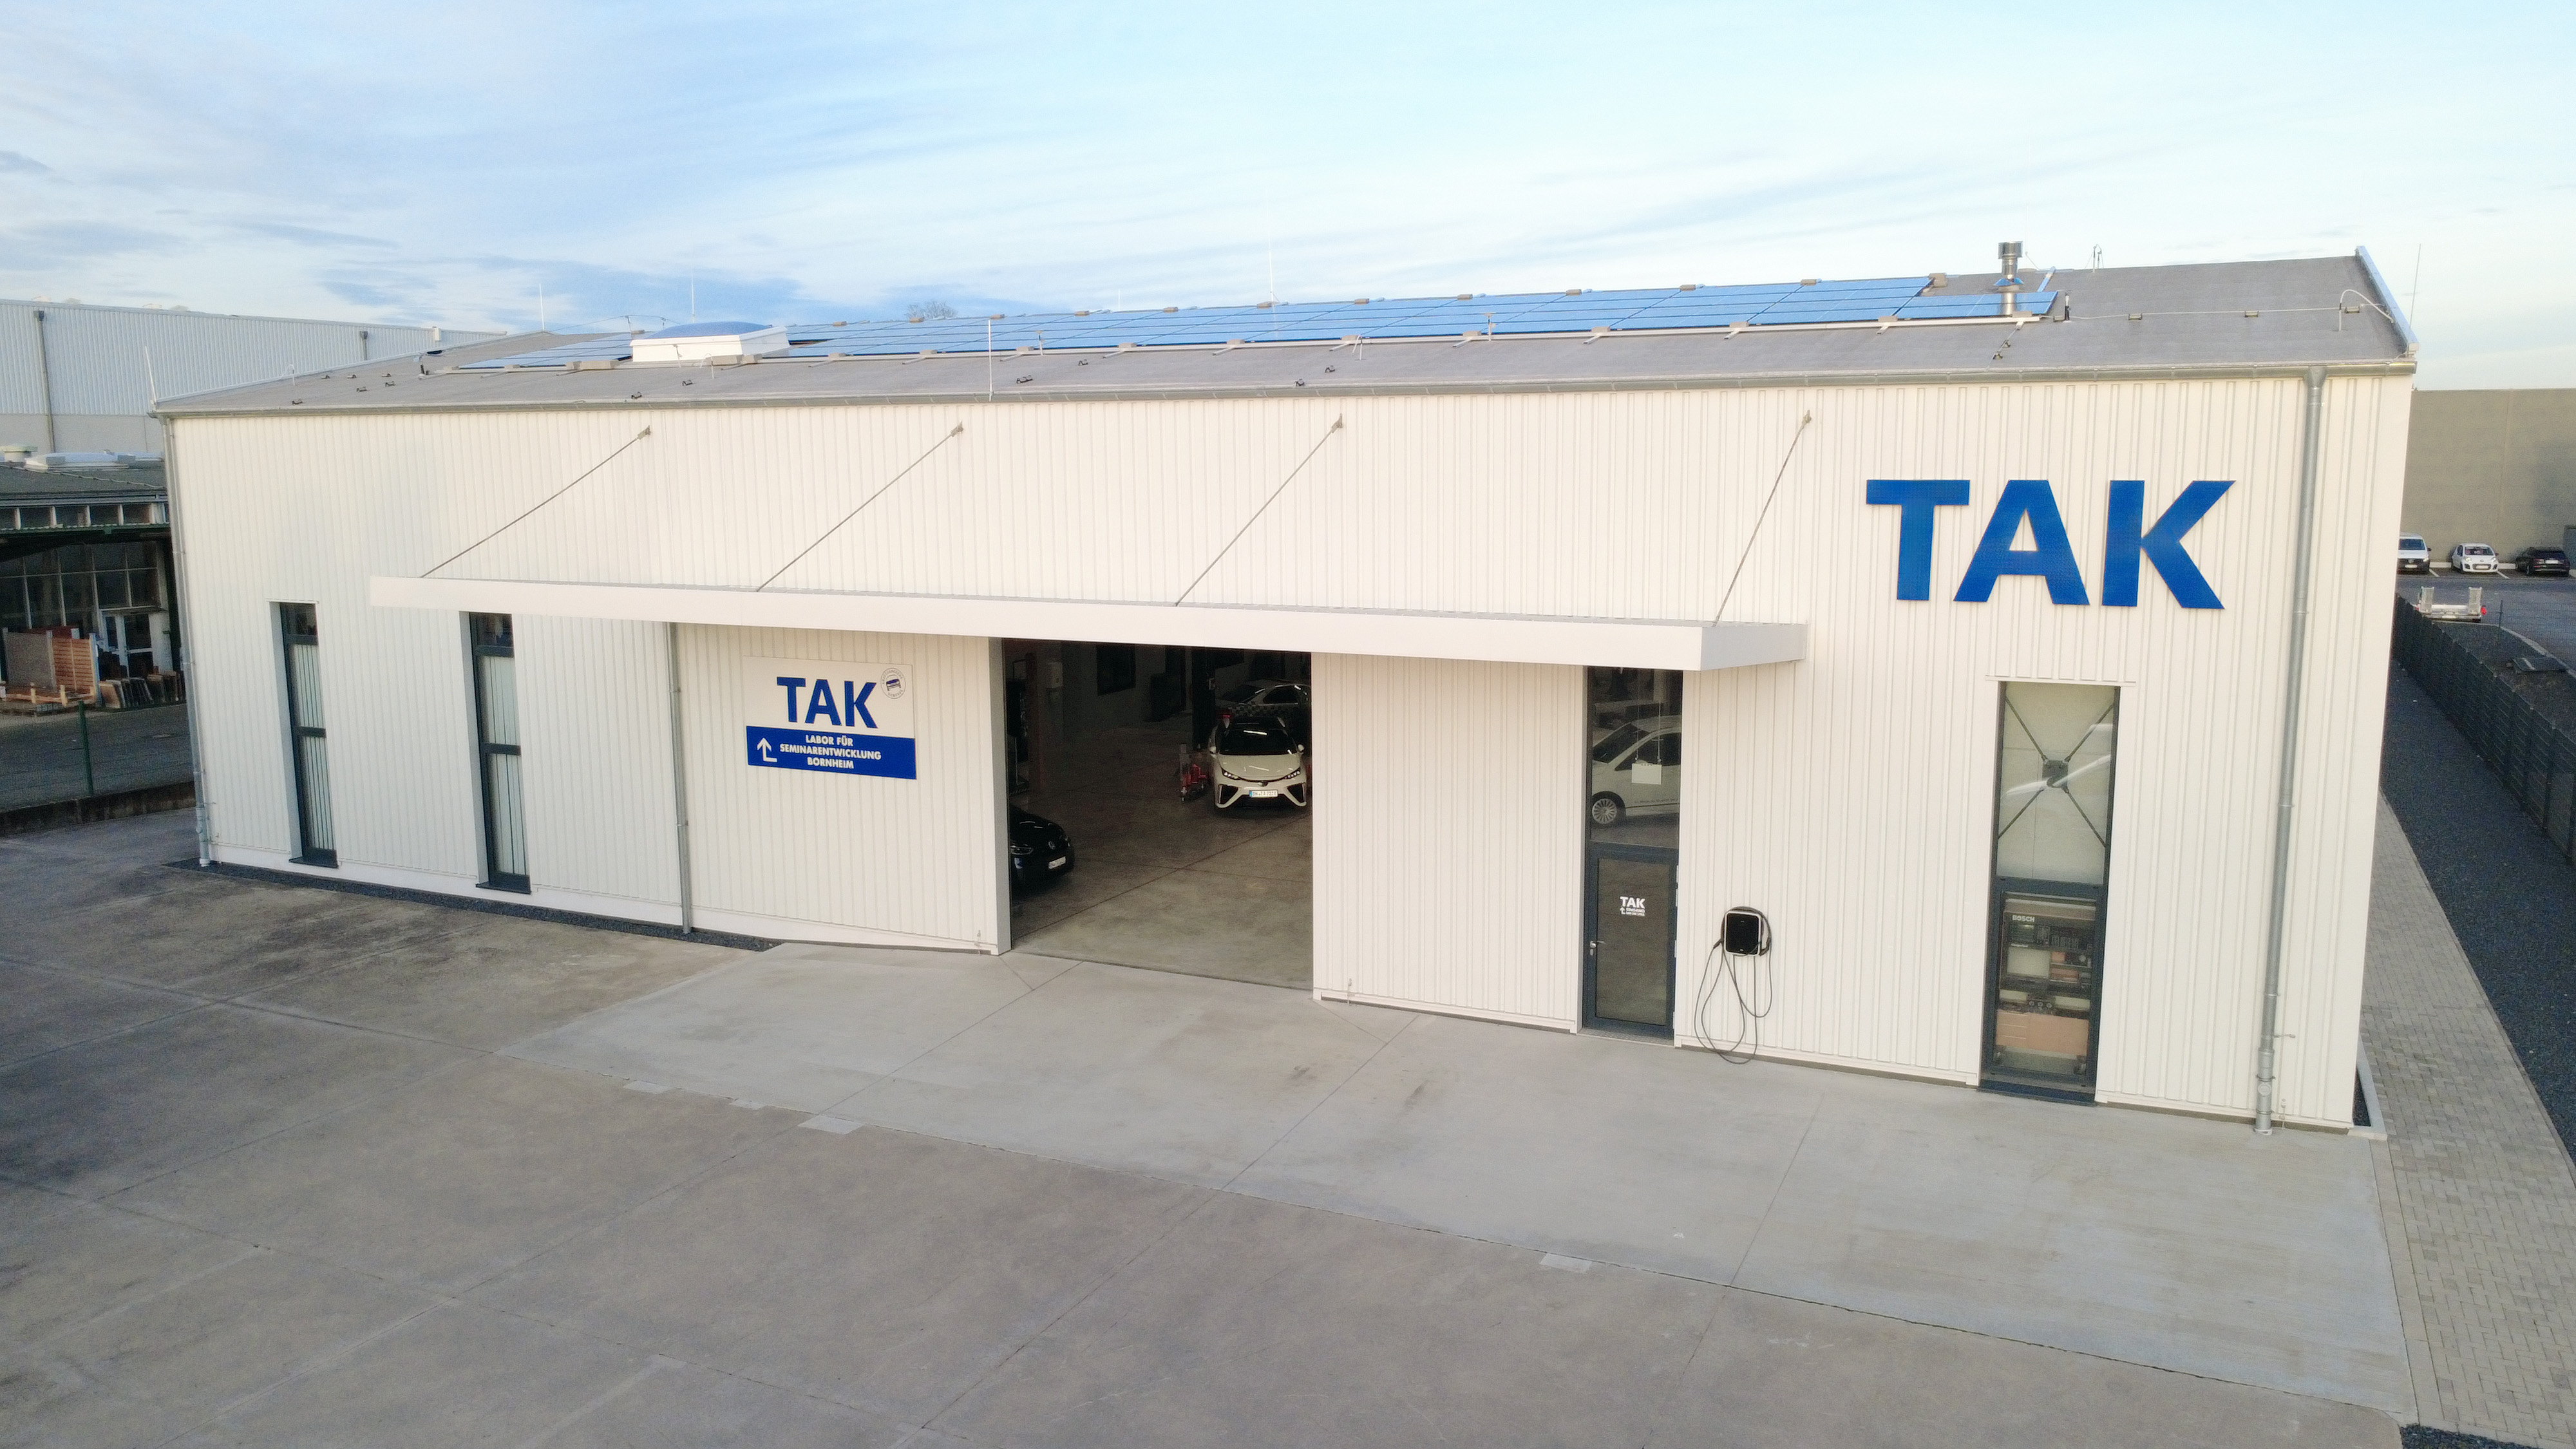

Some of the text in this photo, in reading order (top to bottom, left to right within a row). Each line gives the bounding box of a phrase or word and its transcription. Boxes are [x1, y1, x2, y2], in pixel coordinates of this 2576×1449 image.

[1866, 479, 2237, 610] TAK
[777, 676, 878, 729] TAK
[805, 734, 854, 747] LABOR FÜR
[779, 743, 882, 761] SEMINARENTWICKLUNG
[807, 757, 855, 769] BORNHEIM
[1620, 896, 1645, 909] TAK
